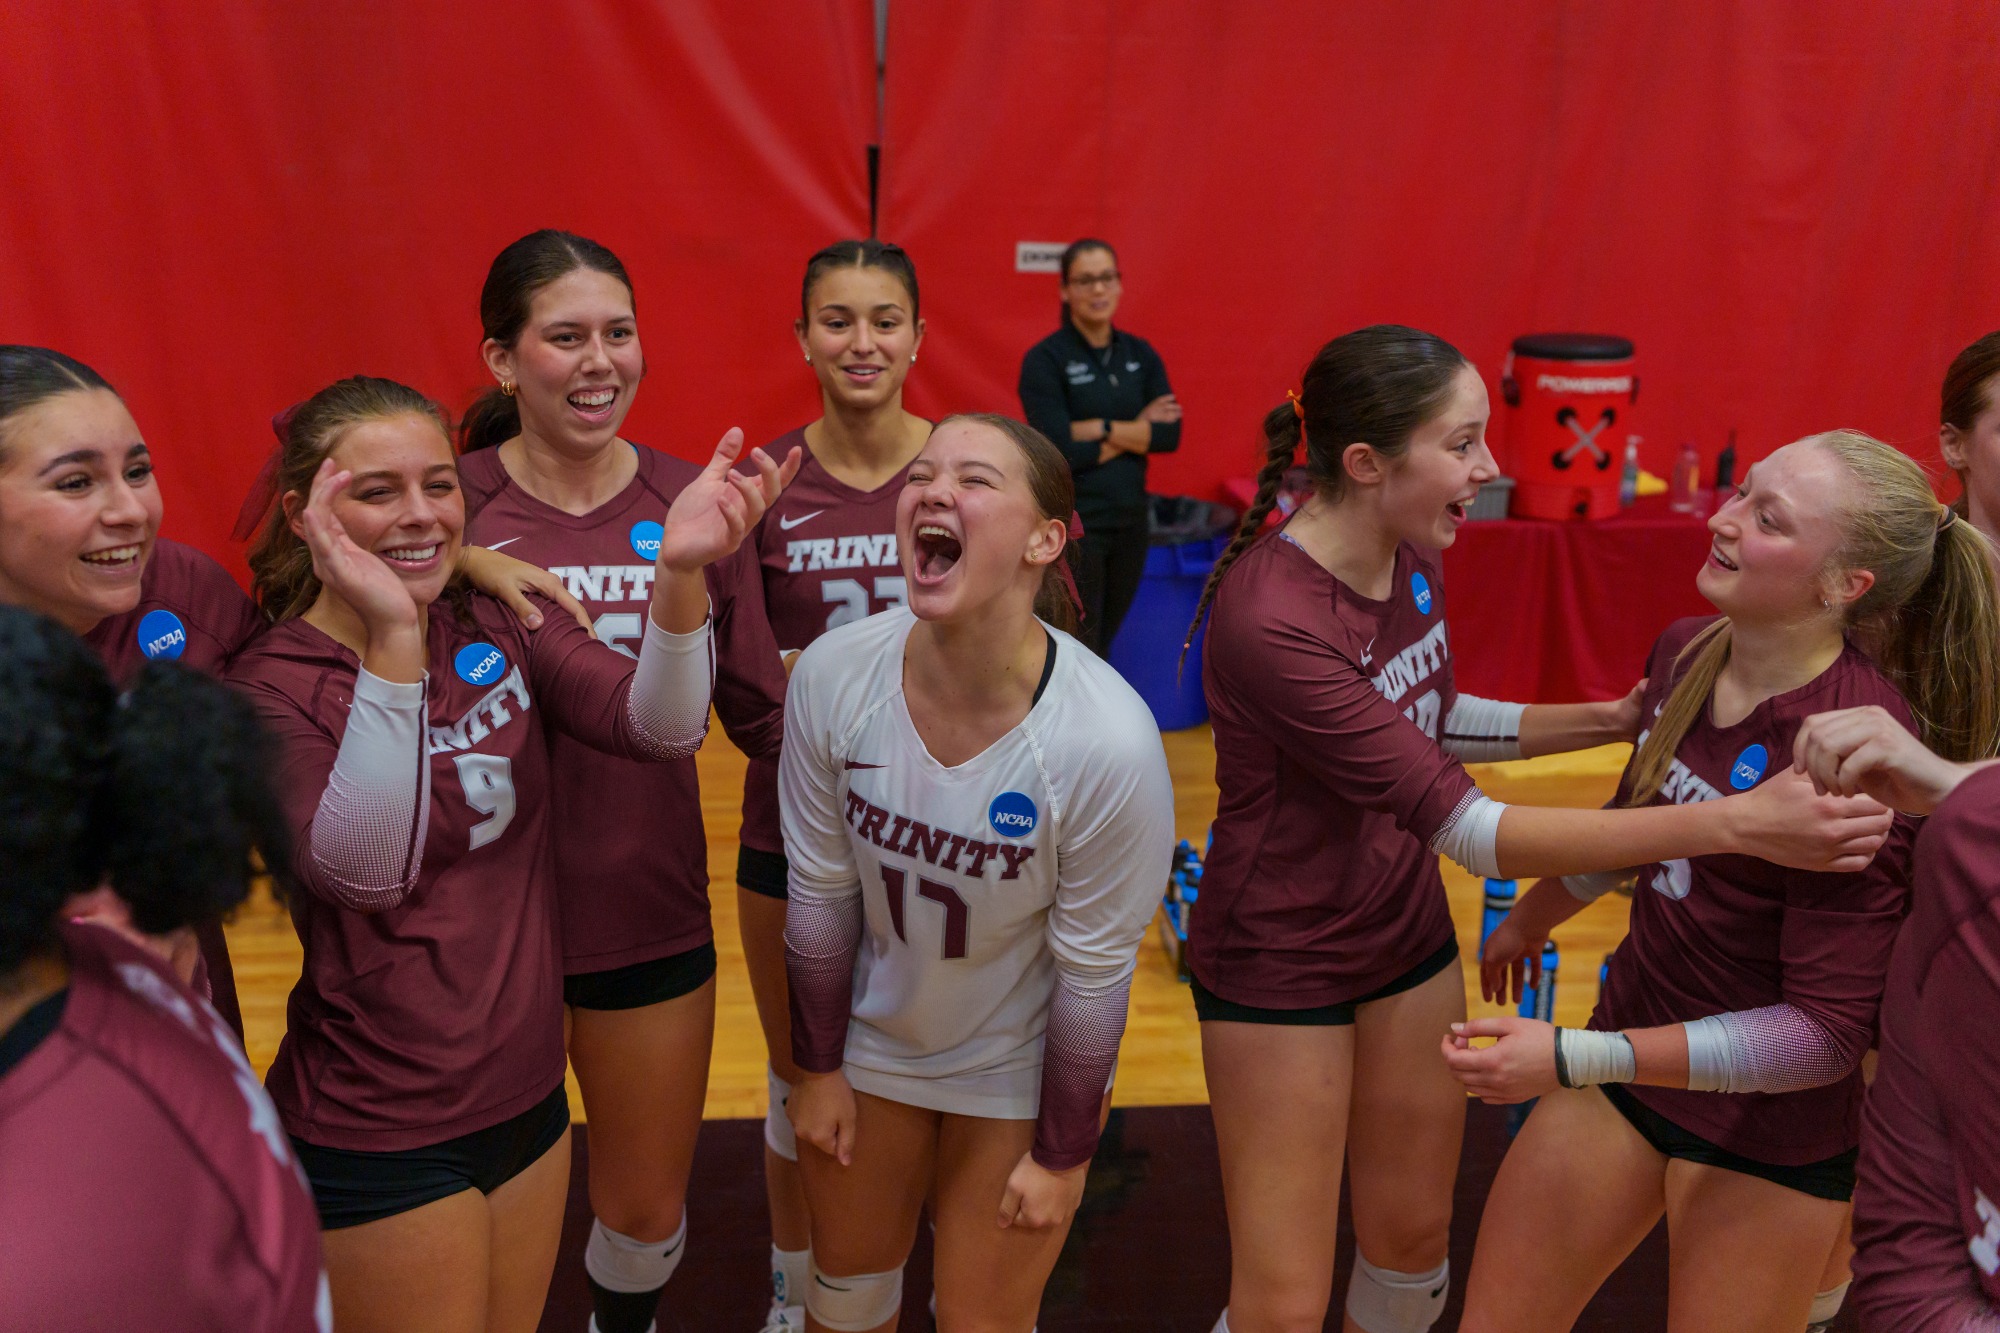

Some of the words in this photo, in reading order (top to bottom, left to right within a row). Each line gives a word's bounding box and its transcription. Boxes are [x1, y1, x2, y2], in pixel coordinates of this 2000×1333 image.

[148, 628, 185, 657] NCAA
[469, 650, 502, 682] NCAA
[1734, 761, 1760, 783] NCAA
[452, 753, 517, 851] 9
[845, 787, 1036, 881] TRINITY
[994, 812, 1034, 829] NCAA
[879, 860, 972, 960] 17
